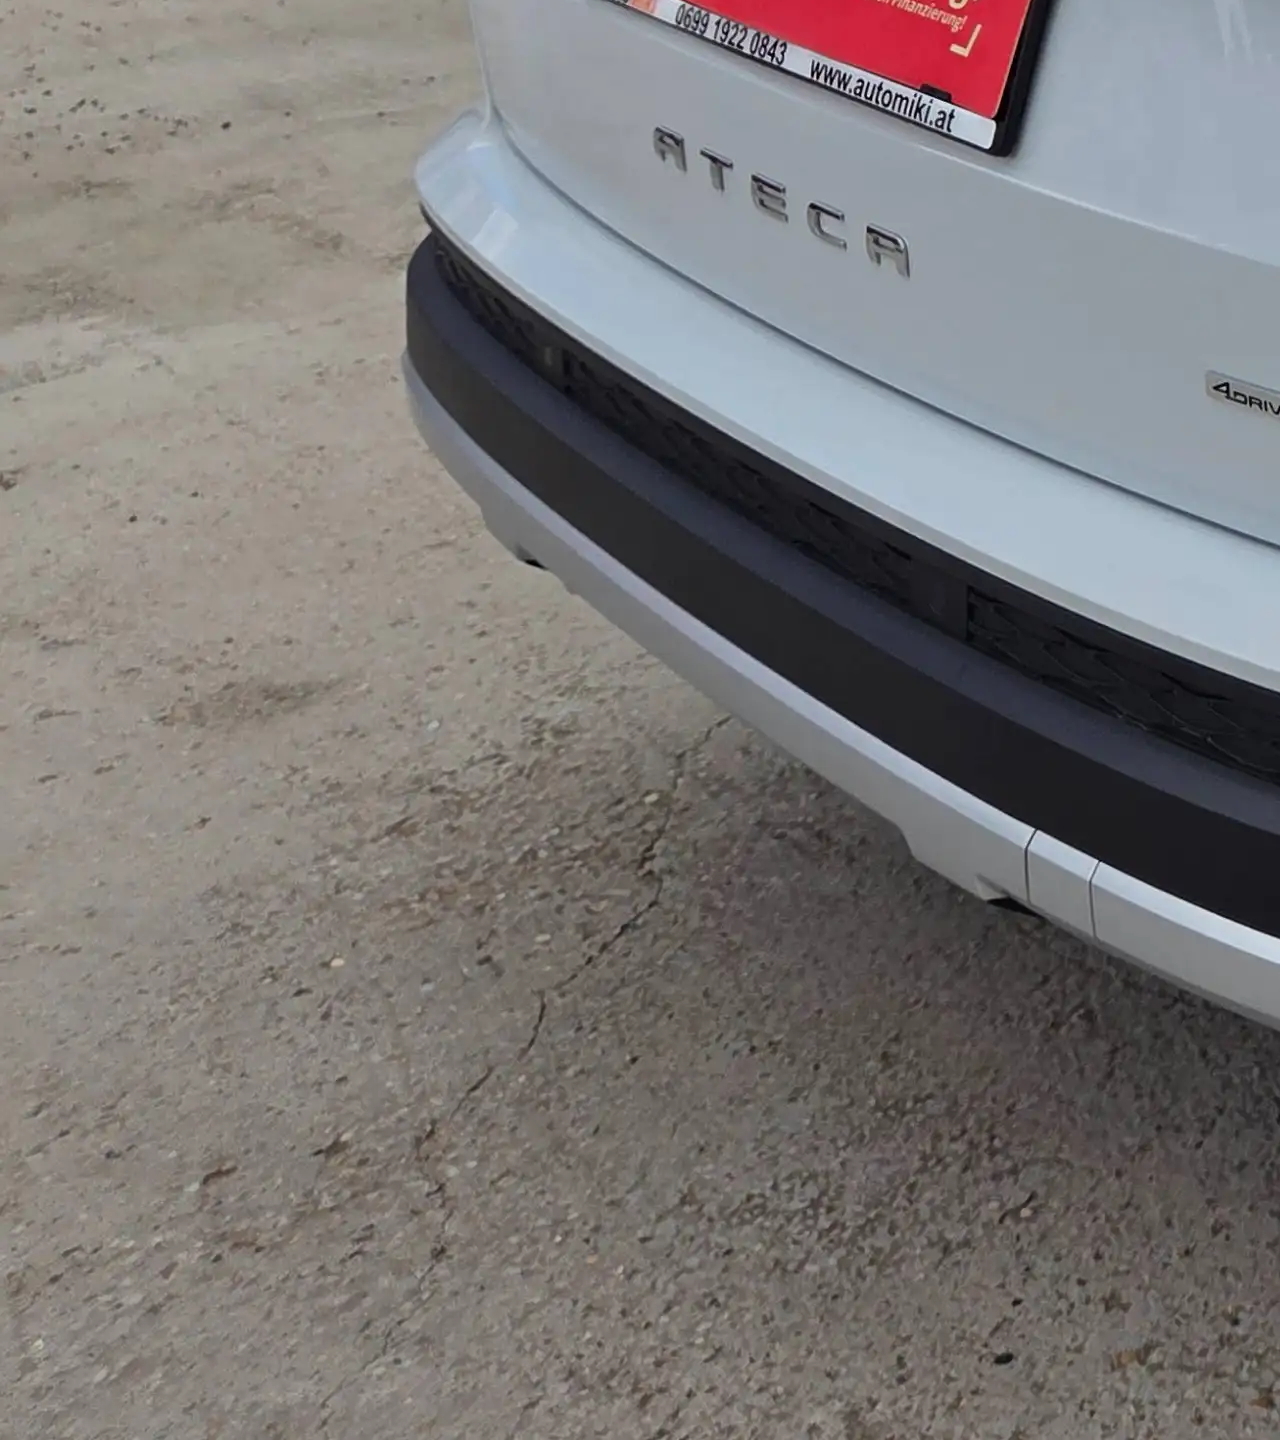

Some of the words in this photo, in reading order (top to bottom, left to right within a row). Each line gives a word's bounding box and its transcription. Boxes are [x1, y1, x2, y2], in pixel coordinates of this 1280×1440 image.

[675, 4, 711, 36] 0699
[713, 17, 748, 50] 1922
[749, 32, 788, 66] 0843
[810, 59, 956, 133] www.automiki.at
[653, 125, 910, 278] ATECA
